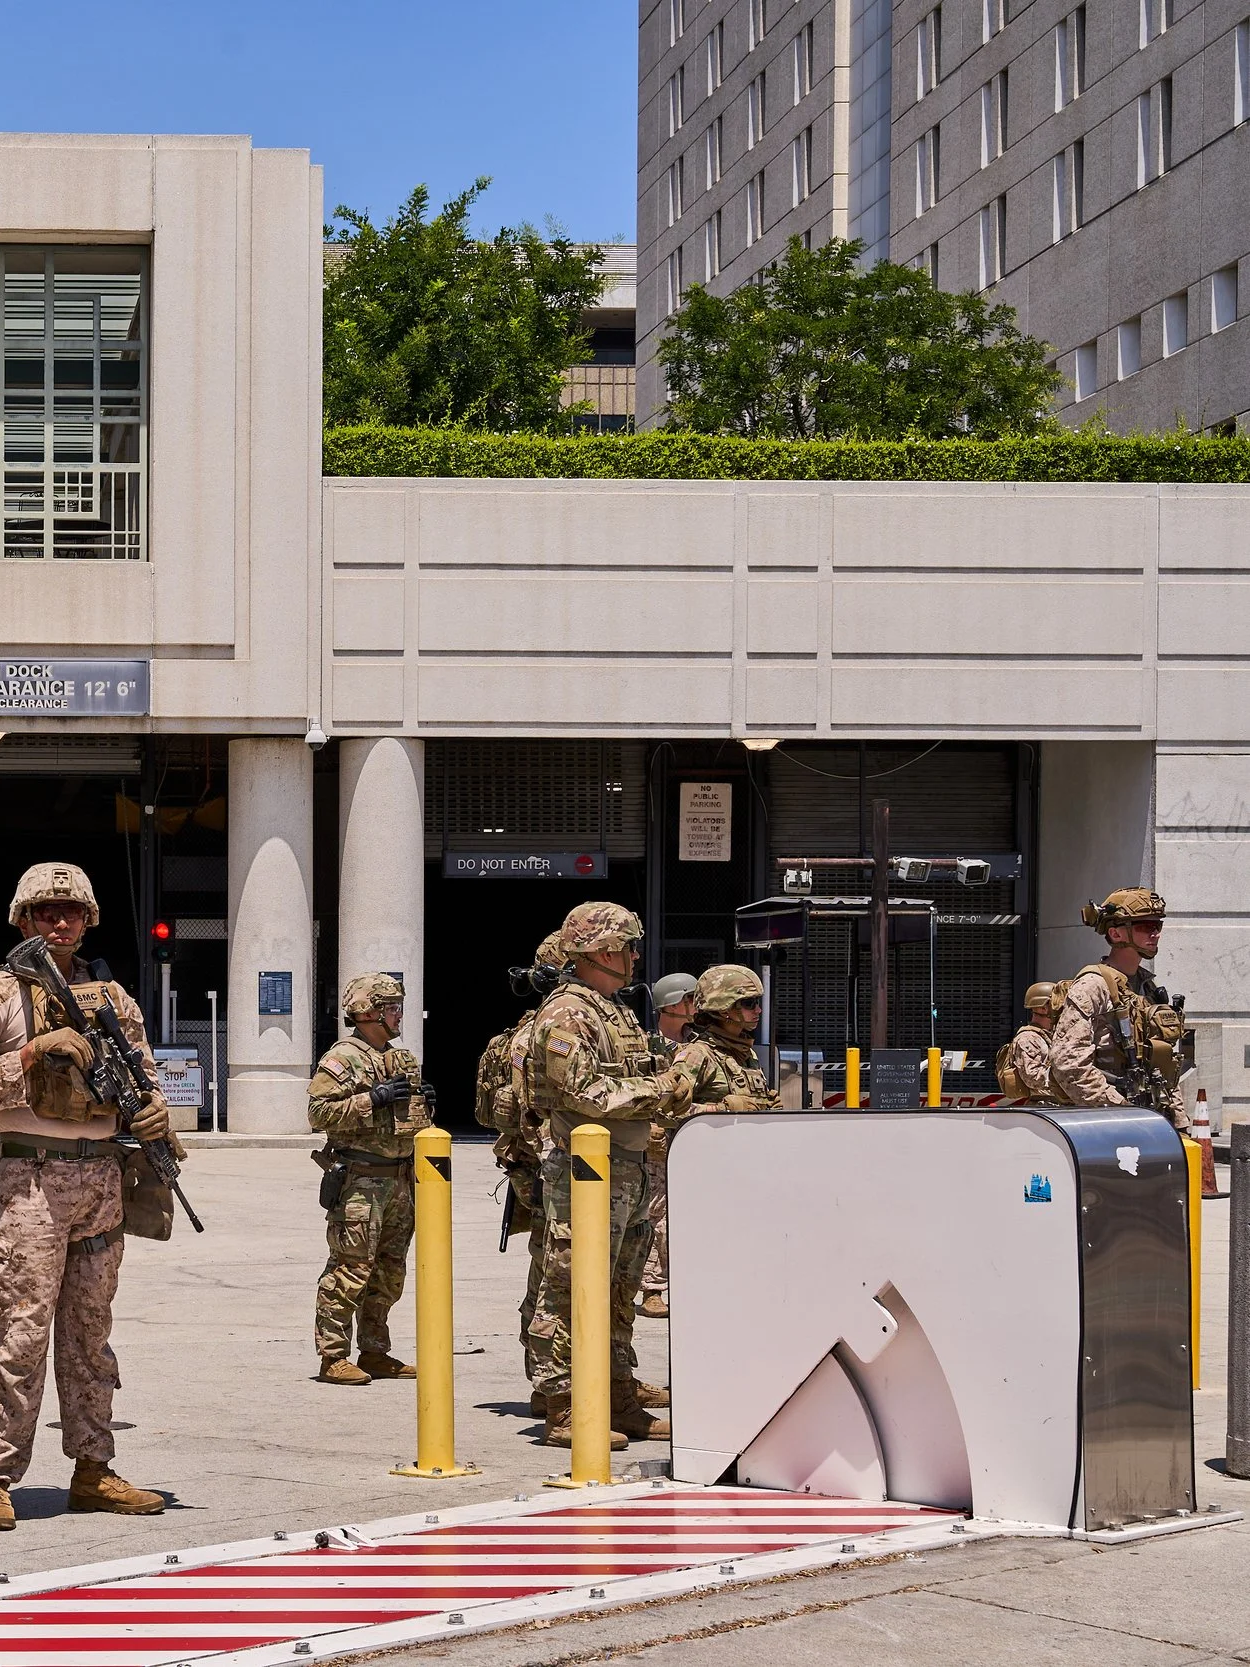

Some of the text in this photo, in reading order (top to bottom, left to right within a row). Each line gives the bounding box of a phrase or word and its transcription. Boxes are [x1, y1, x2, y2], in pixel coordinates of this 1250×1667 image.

[6, 664, 53, 678] DOCK
[84, 681, 111, 697] 12'
[117, 681, 137, 697] 6"
[686, 817, 726, 825] VIOLATORS
[710, 825, 721, 833] BE
[687, 833, 725, 841] TOWED AT
[457, 859, 550, 870] DO NOT ENTER
[164, 1072, 188, 1081] STOP!
